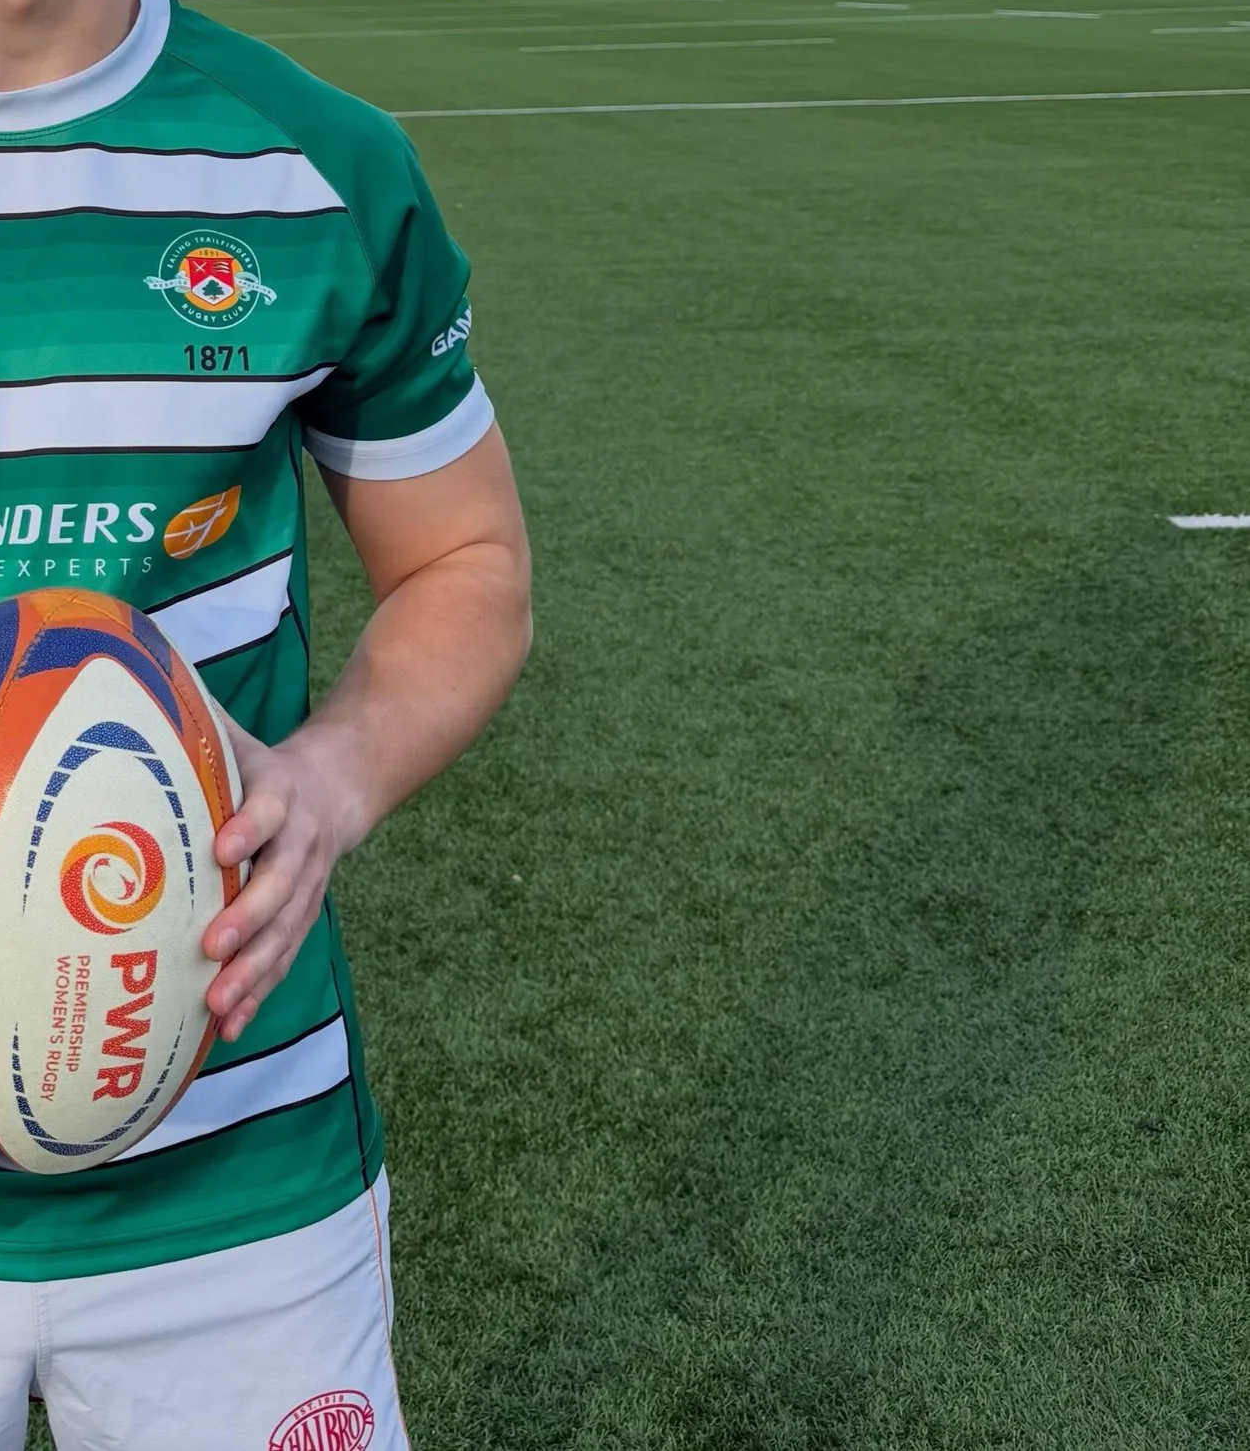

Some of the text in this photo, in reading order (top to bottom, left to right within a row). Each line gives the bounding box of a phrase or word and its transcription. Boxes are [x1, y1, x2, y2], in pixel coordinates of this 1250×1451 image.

[167, 241, 191, 268] EALING
[181, 303, 244, 322] RUGBY CLUB
[183, 345, 250, 371] 1871
[40, 955, 71, 1102] WOMEN'S RUGBY
[66, 954, 91, 1073] PREMIERSHIP
[92, 949, 158, 1102] PWR
